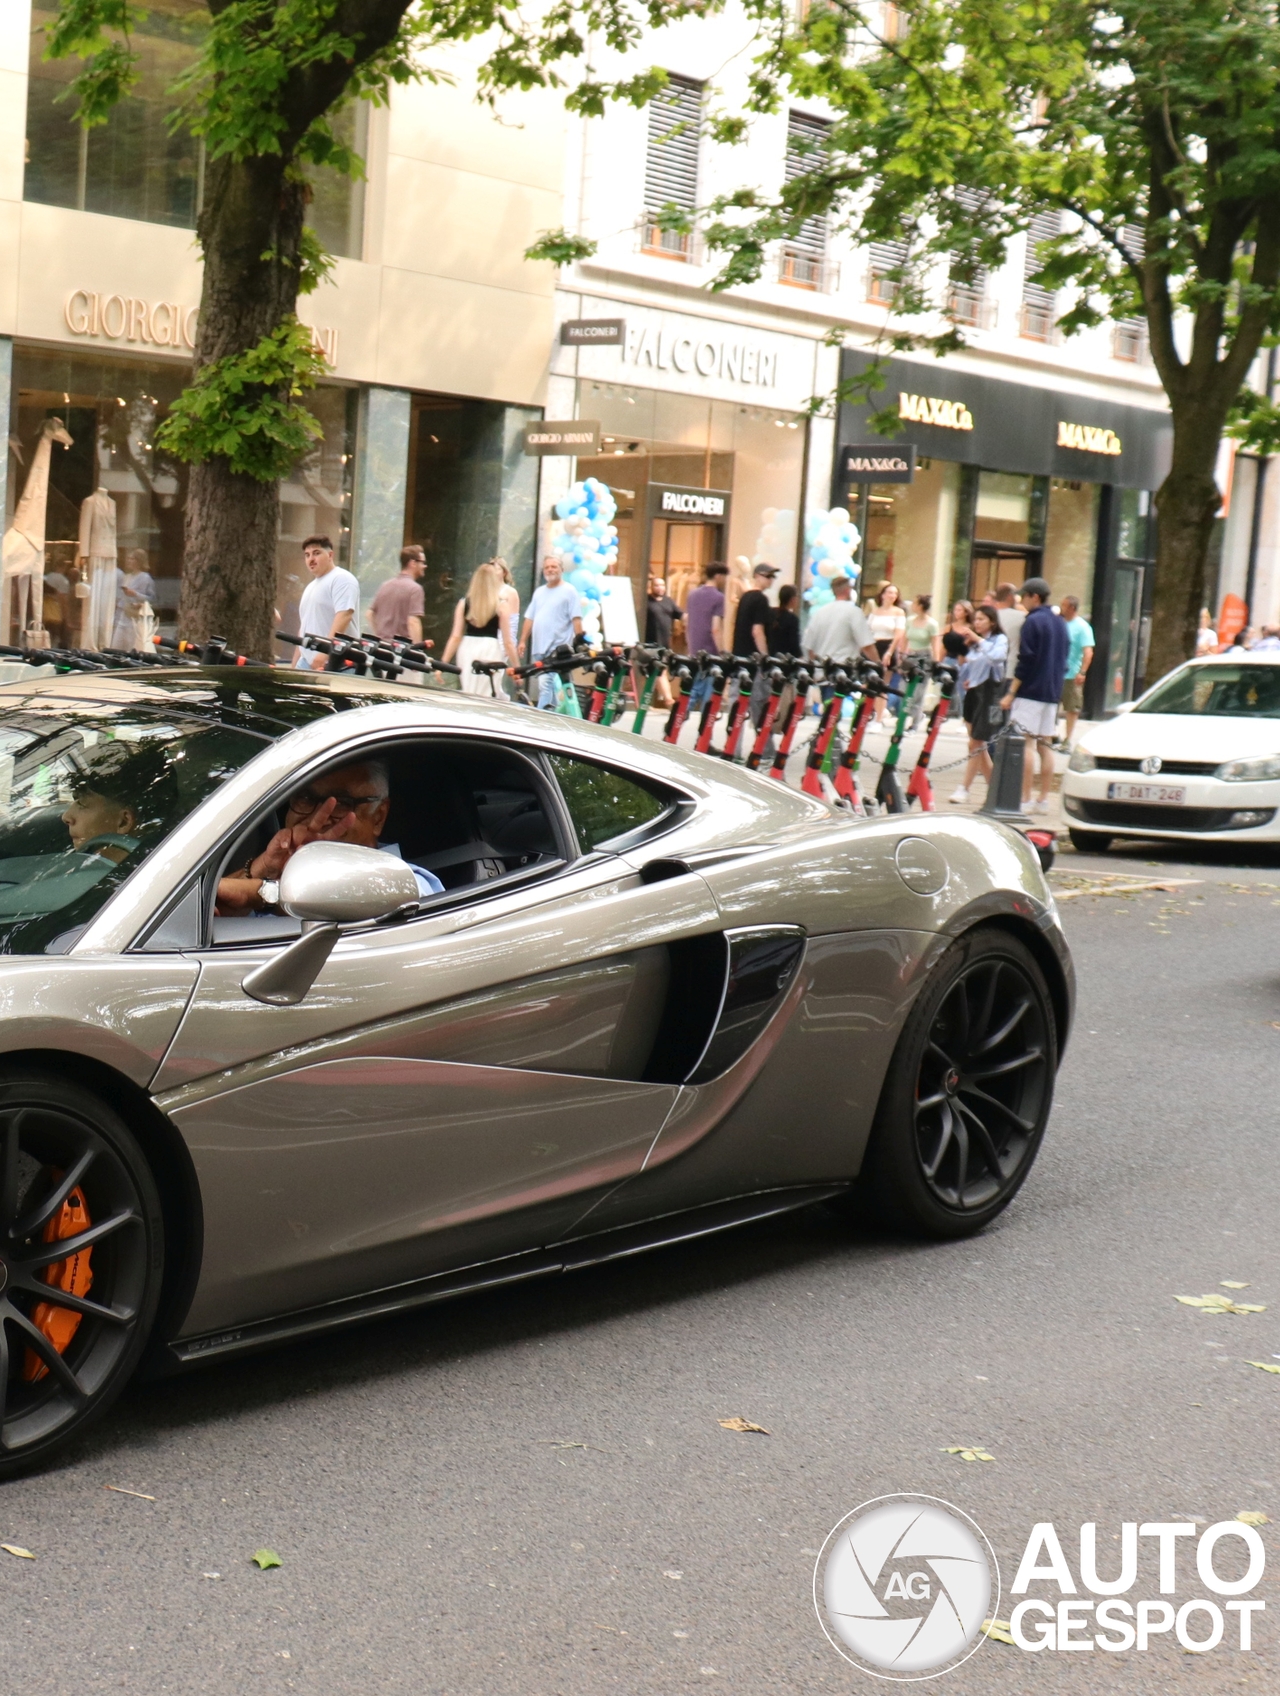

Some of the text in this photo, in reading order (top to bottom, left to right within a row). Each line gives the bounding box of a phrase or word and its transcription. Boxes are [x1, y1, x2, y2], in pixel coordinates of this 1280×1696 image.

[569, 326, 618, 338] FALCONERI
[621, 328, 778, 388] FALCONERI
[898, 391, 974, 431] MAX&Co.
[527, 432, 594, 444] GIORGIO ARMANI
[1056, 421, 1122, 456] MAX&Co.
[847, 457, 909, 472] MAX&Co.
[662, 491, 725, 517] FALCONERI
